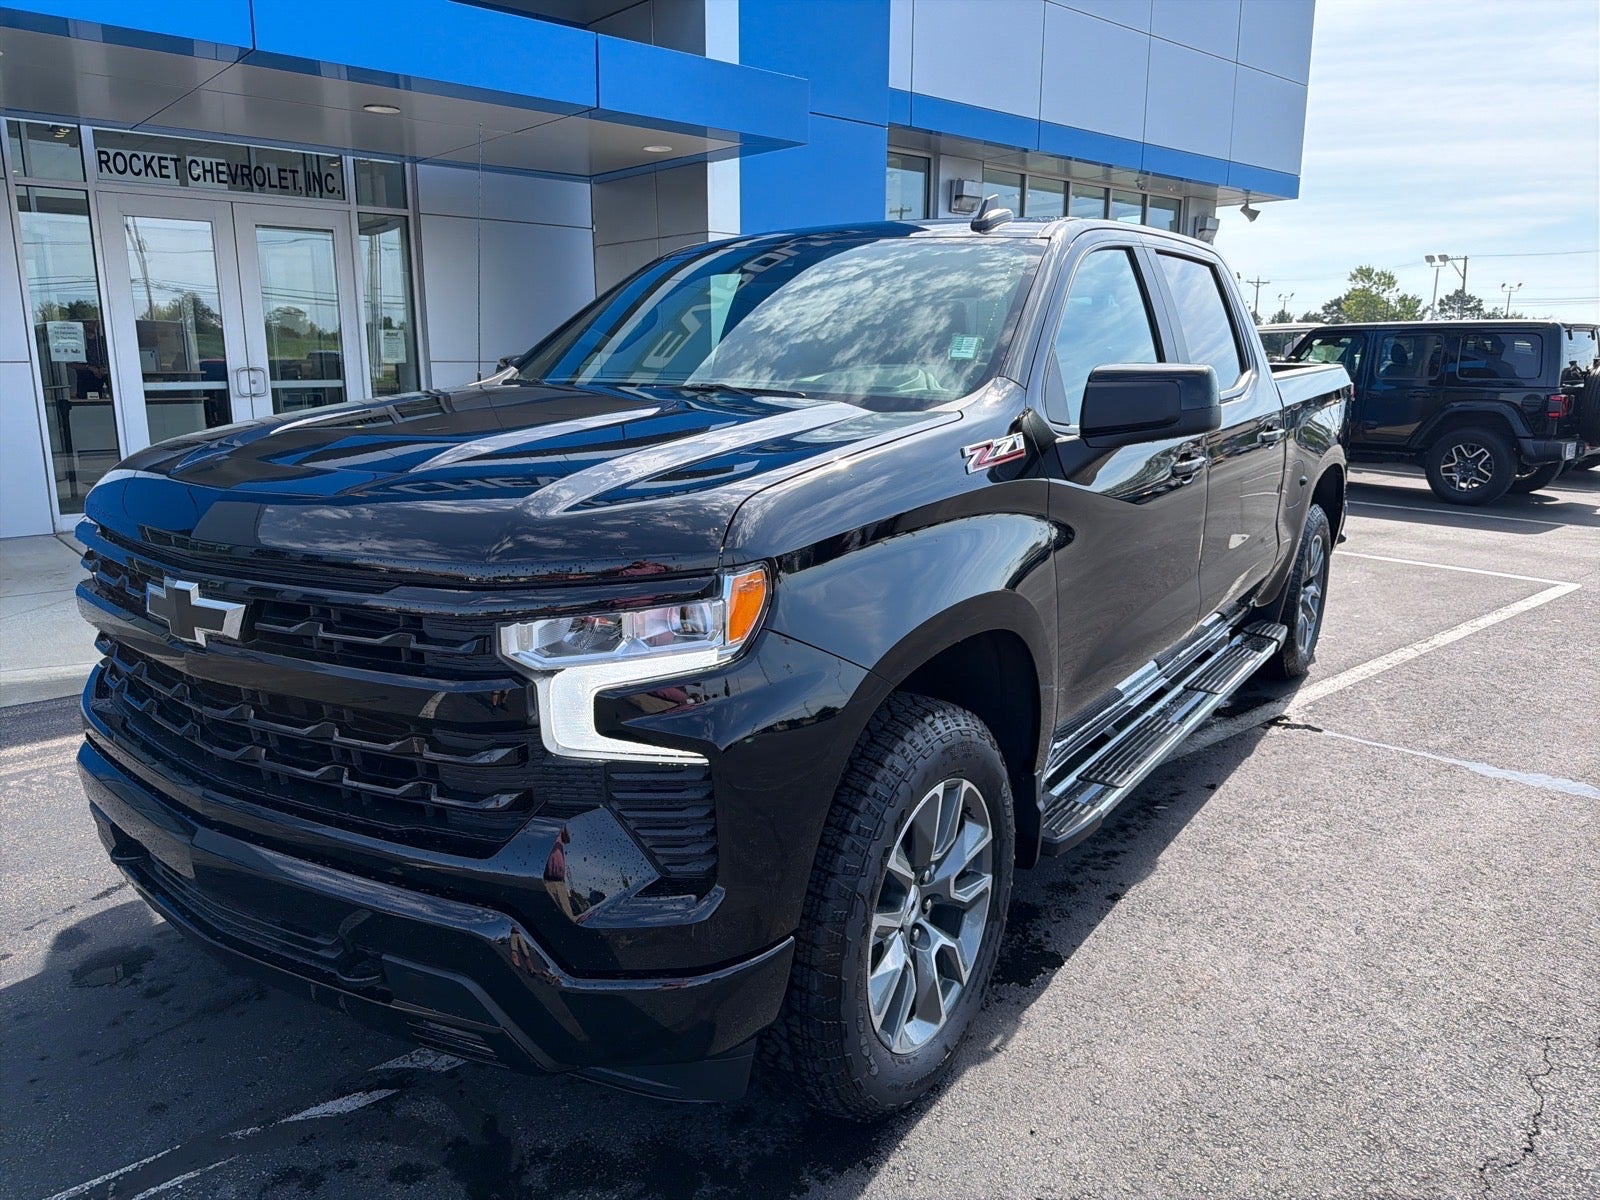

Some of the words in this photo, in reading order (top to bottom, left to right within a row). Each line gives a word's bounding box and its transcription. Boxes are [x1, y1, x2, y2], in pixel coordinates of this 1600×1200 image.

[97, 150, 181, 179] ROCKET
[187, 159, 303, 193] CHEVROLET,
[306, 171, 341, 194] INC.
[960, 432, 1026, 475] Z71
